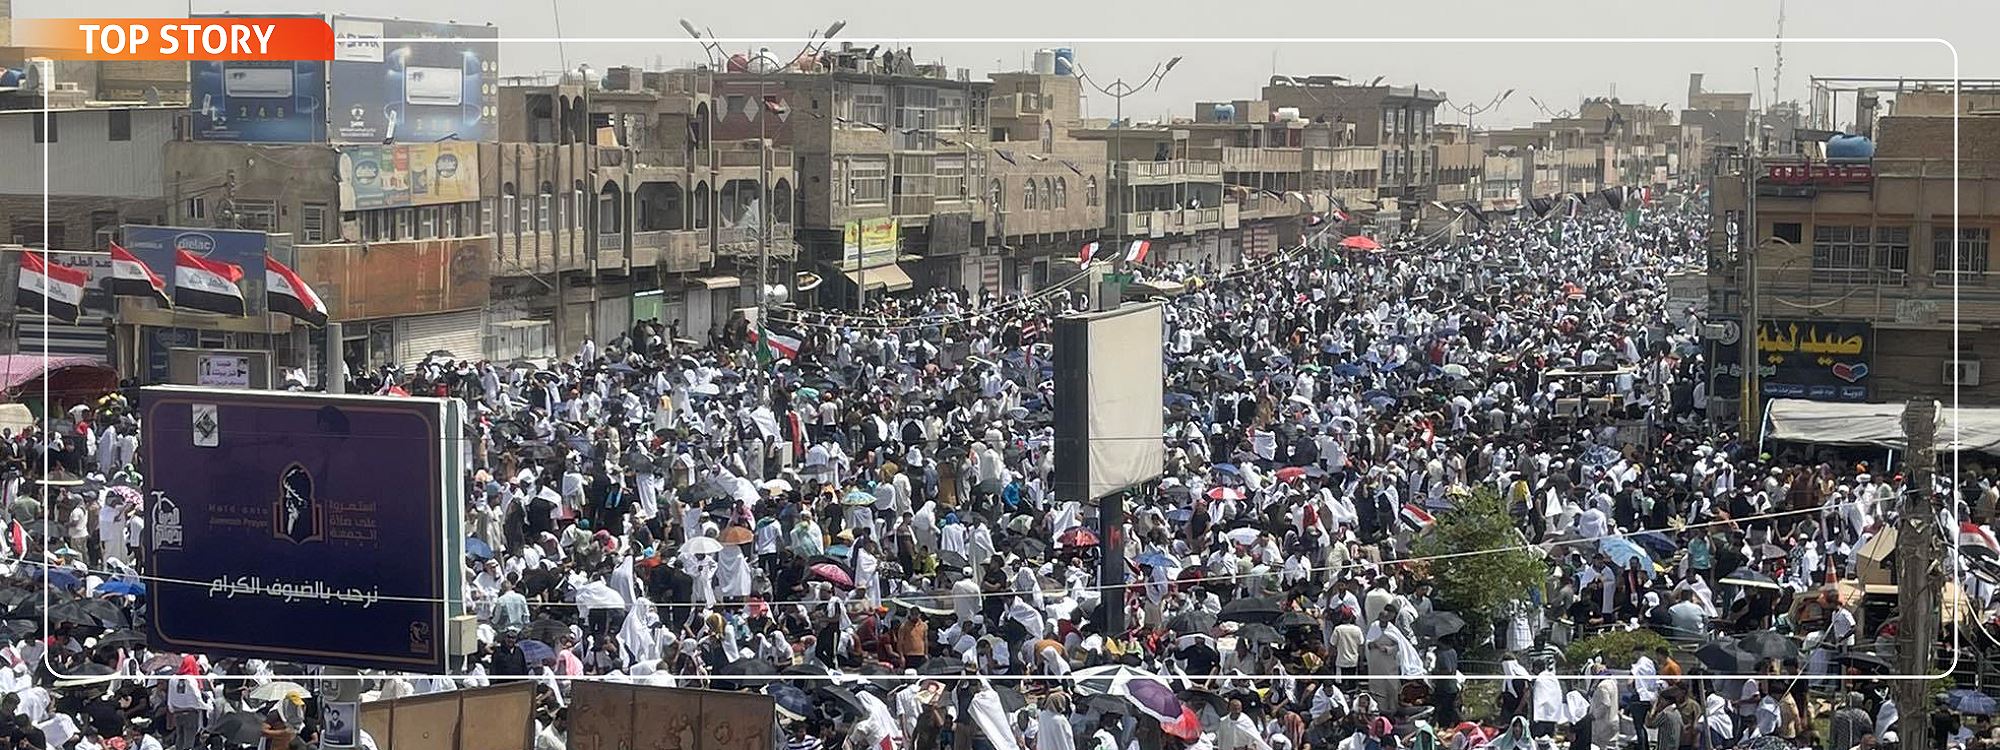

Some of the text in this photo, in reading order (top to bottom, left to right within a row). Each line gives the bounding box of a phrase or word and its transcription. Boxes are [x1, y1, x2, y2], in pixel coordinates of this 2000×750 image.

[209, 575, 379, 608] نرحب بالضيوف الكرام
